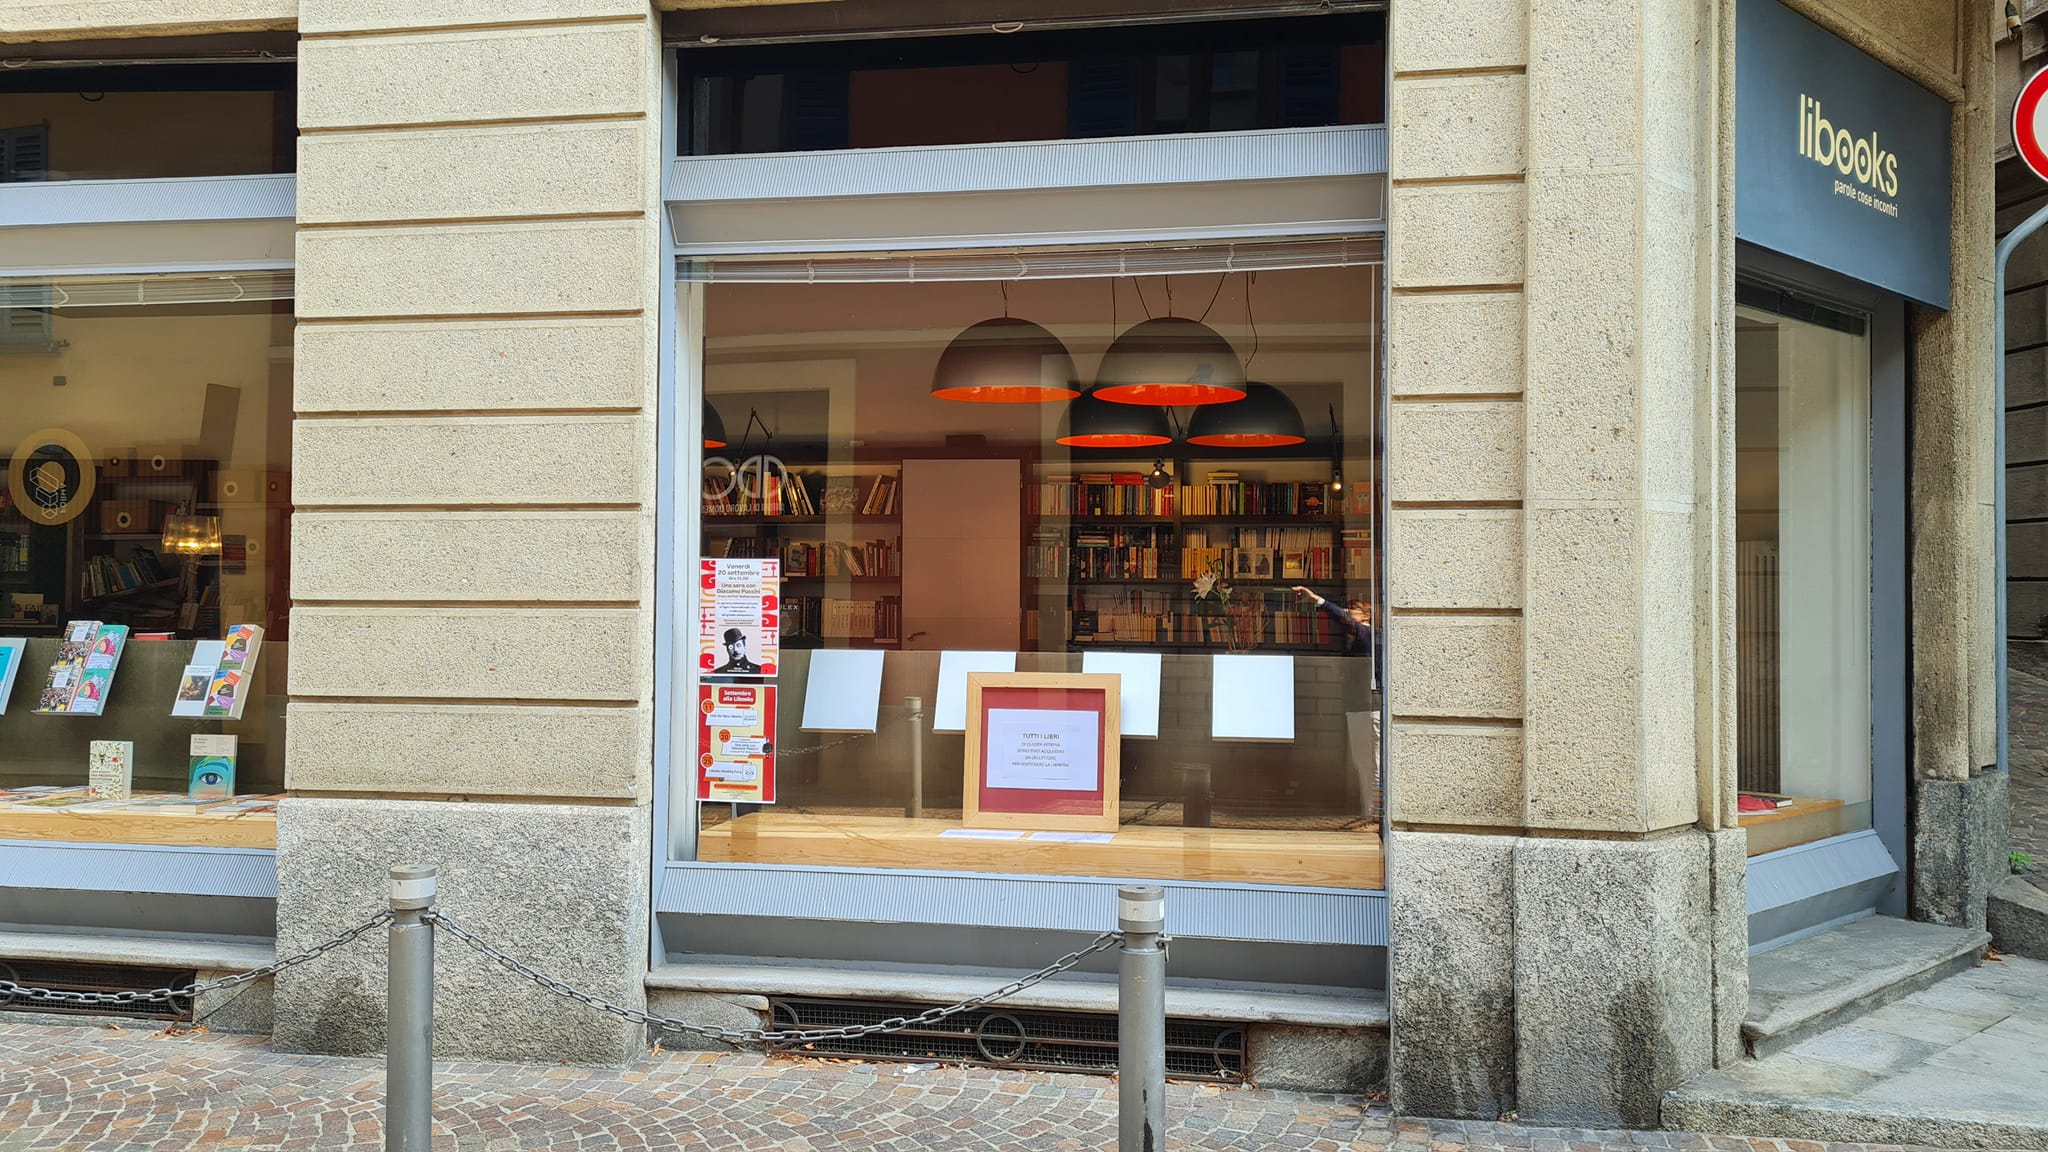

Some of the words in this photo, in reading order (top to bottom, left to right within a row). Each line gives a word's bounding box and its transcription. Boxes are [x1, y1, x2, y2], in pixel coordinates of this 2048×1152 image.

[1799, 93, 1898, 198] libooks
[1834, 179, 1857, 199] parole
[1857, 190, 1873, 207] cose
[1873, 193, 1898, 218] incontri
